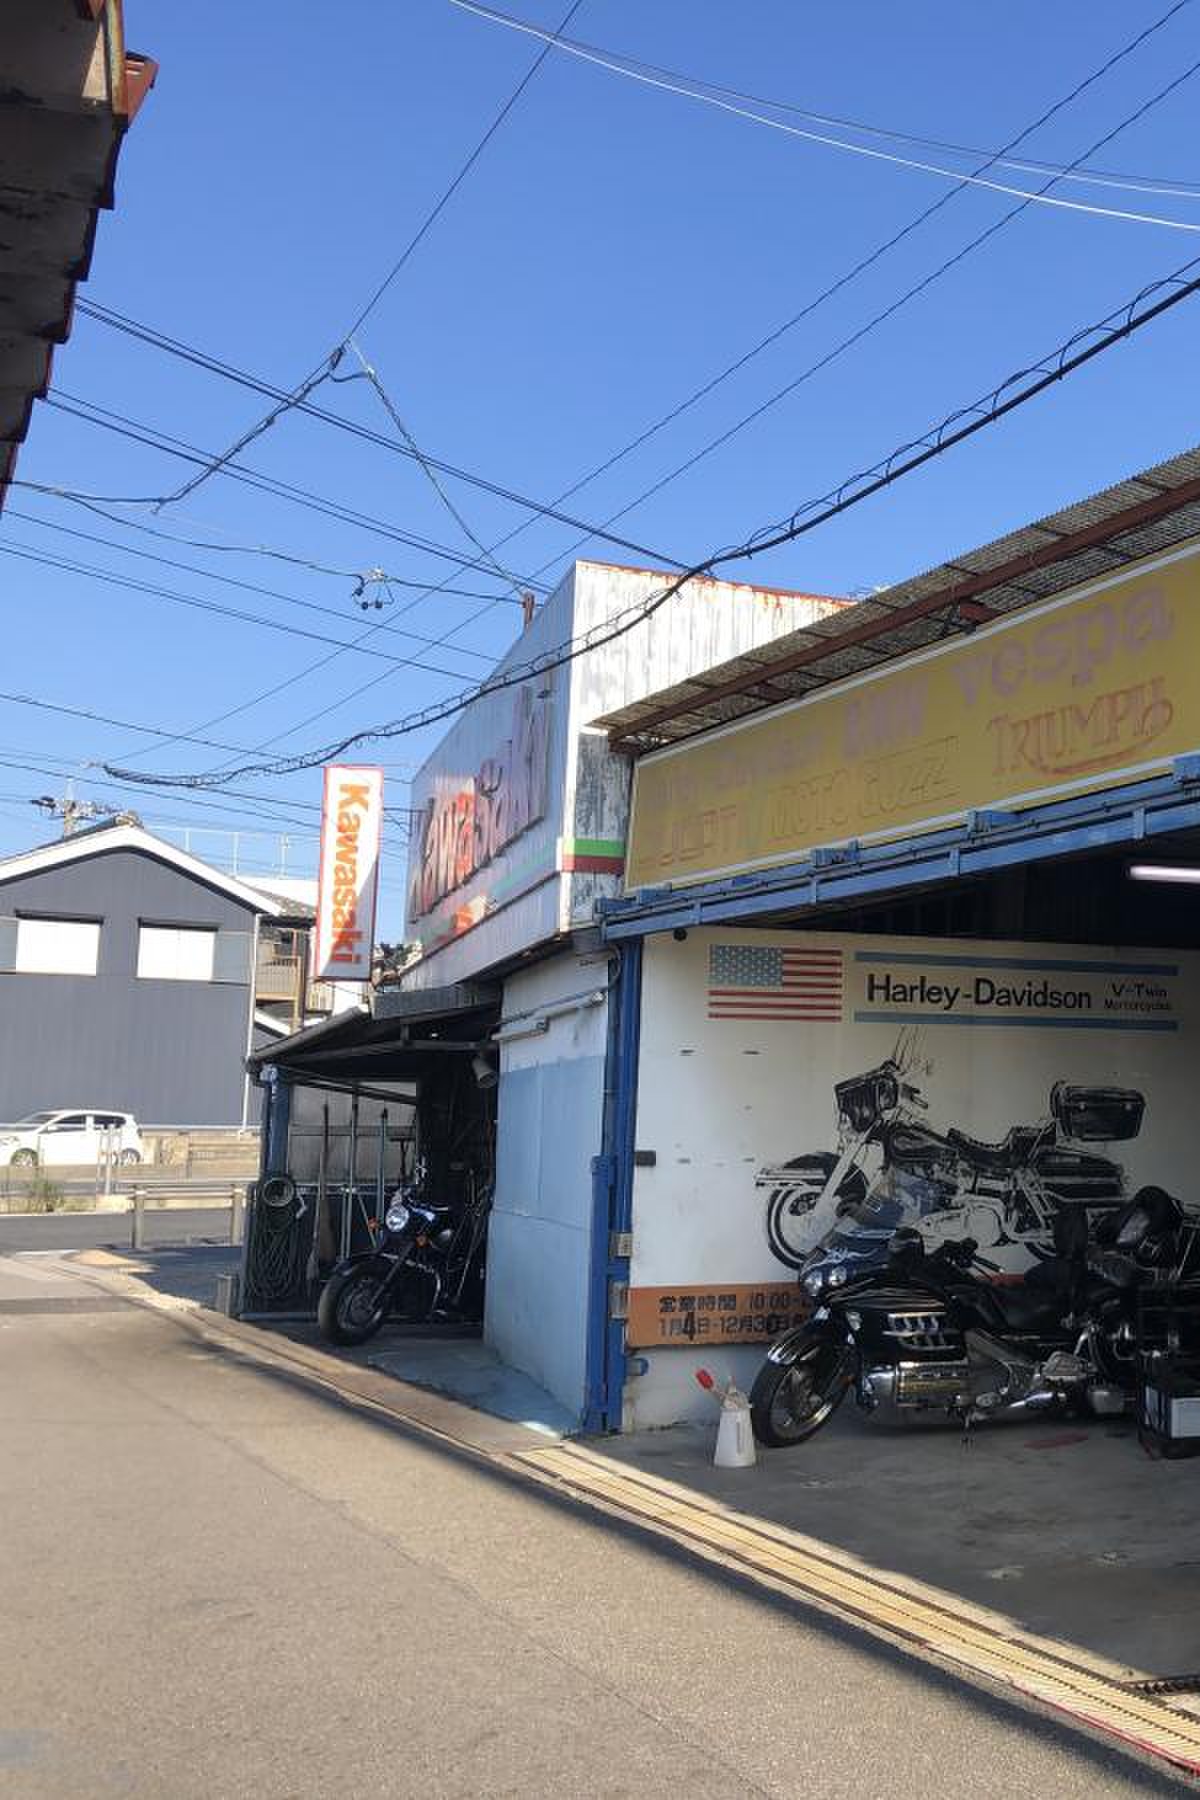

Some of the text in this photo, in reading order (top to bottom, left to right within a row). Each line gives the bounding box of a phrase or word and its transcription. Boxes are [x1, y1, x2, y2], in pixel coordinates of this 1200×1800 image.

[331, 783, 370, 964] Kawasaki
[866, 973, 1168, 1010] Harley-Davidson V-Twin
